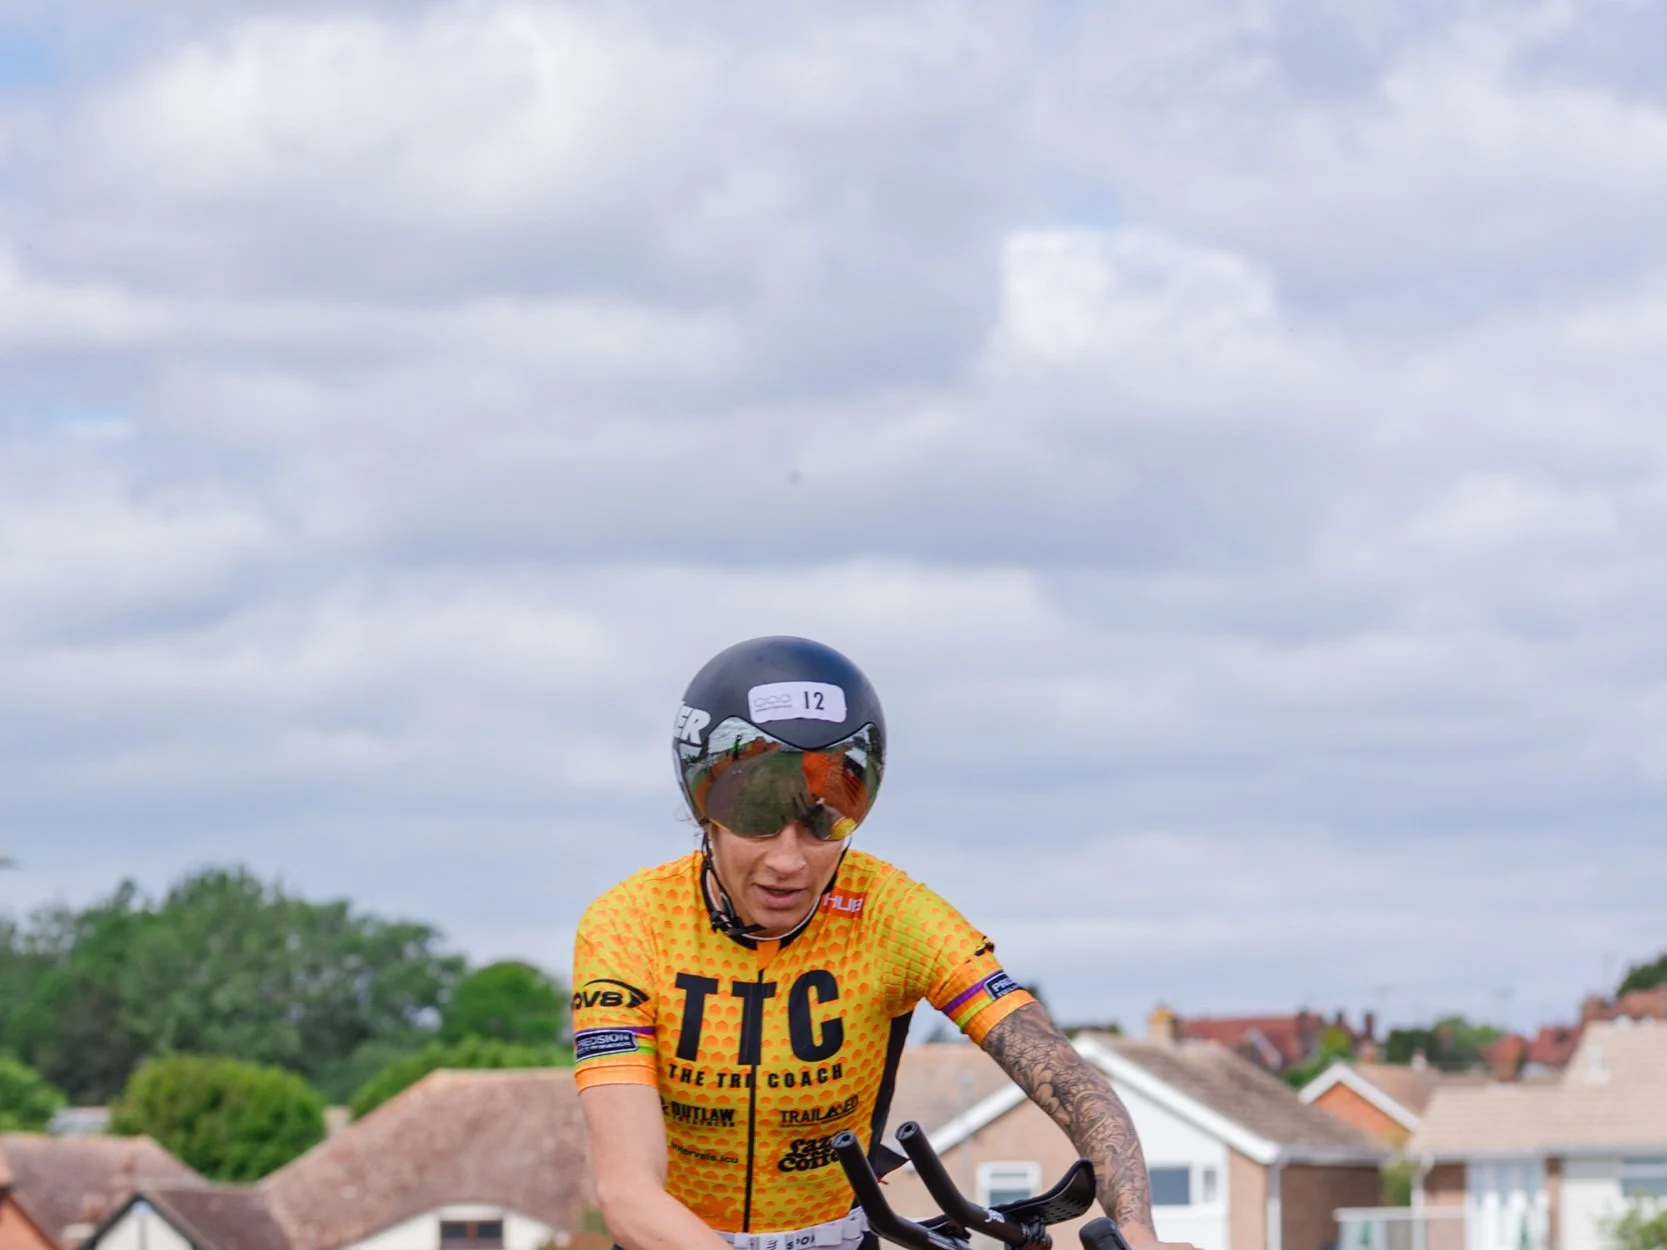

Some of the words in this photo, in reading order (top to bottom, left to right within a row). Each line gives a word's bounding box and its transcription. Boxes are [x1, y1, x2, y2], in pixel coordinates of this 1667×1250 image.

[803, 691, 825, 711] 12
[675, 969, 844, 1066] TTC
[669, 1063, 705, 1087] THE
[717, 1072, 752, 1089] TRI
[768, 1063, 843, 1089] COACH
